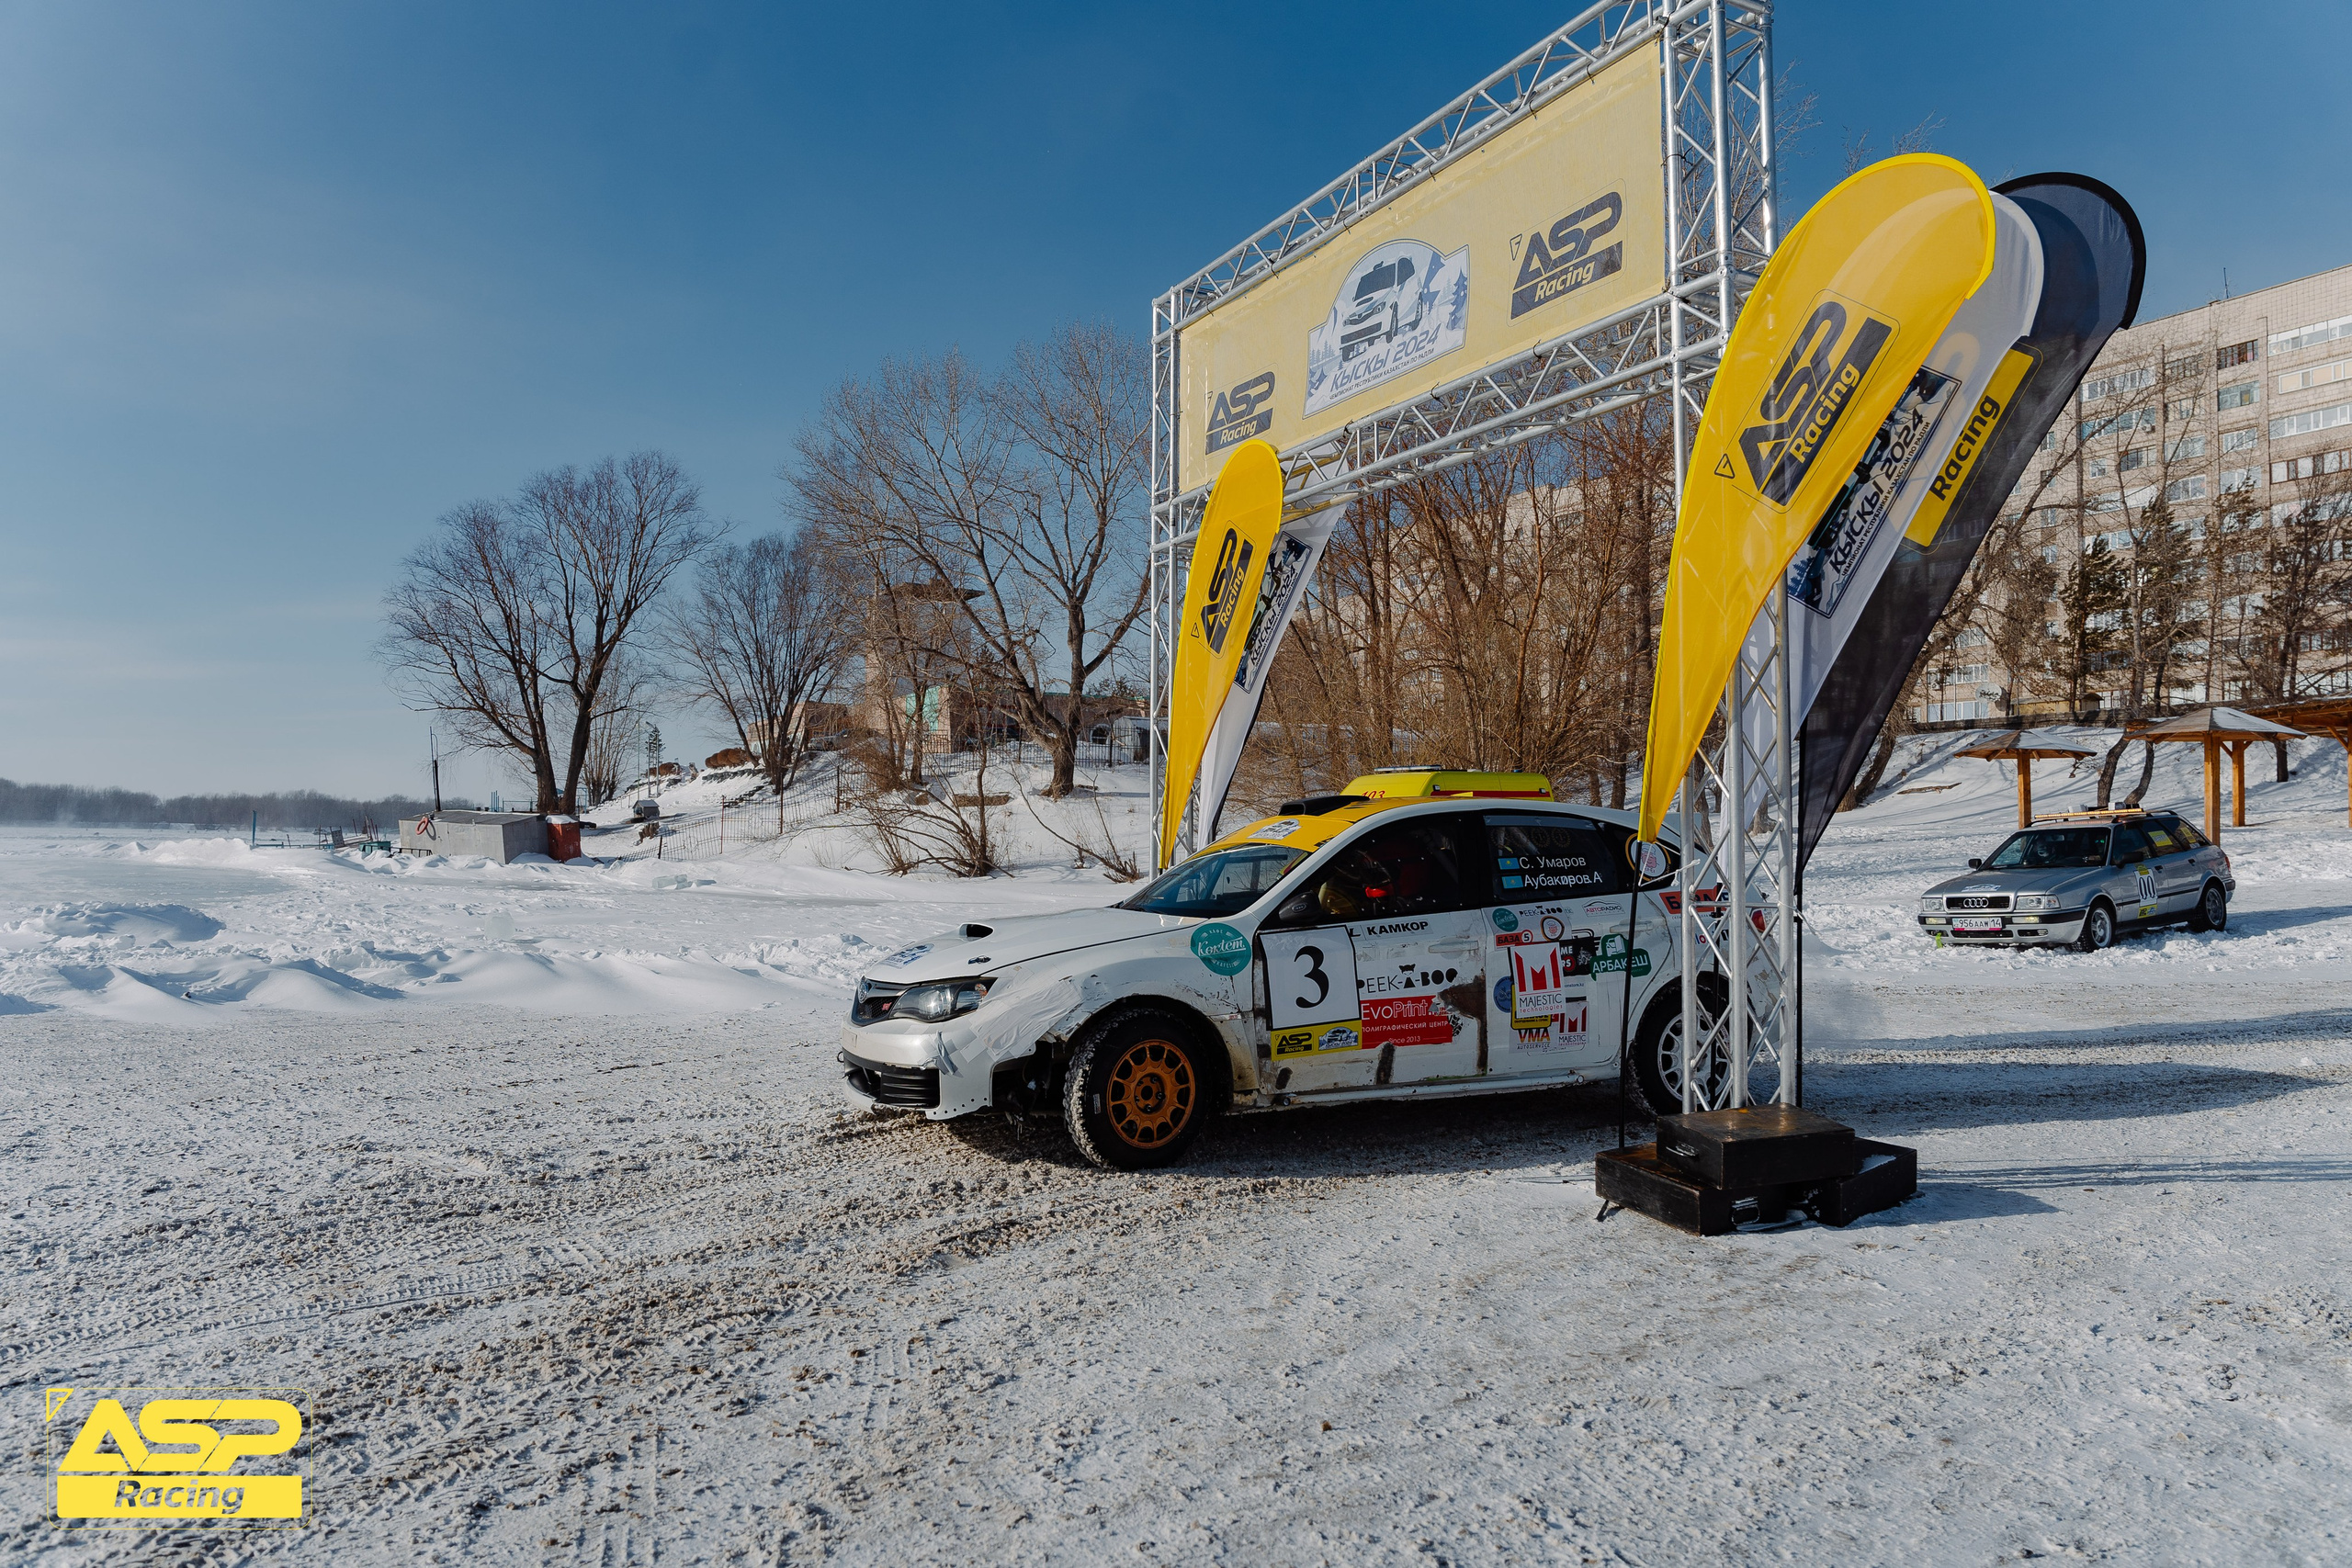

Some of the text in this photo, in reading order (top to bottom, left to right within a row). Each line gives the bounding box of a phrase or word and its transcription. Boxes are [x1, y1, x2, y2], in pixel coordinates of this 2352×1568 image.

[1513, 191, 1623, 290] ASP
[1534, 261, 1596, 302] Racing
[1392, 322, 1442, 364] 2024
[1206, 371, 1275, 433] ASP
[1738, 301, 1847, 491] ASP
[1789, 362, 1860, 464] Racing
[1220, 420, 1257, 445] Racing
[1880, 407, 1925, 481] 2024
[1929, 394, 2001, 502] Racing
[1841, 537, 1866, 577] ЧЕМПИОНАТ
[1864, 493, 1889, 538] РЕСПУБЛИКИ
[1886, 455, 1911, 496] КАЗАХСТАН
[1908, 444, 1917, 457] ПО
[1201, 528, 1238, 646] ASP
[1219, 566, 1244, 628] Racing
[1276, 566, 1296, 608] 2024
[1519, 856, 1587, 870] С. Умаров
[1366, 921, 1429, 935] КАМКОР
[1585, 905, 1623, 914] АВТОРАДИО
[1990, 919, 2001, 928] 14
[1498, 933, 1530, 944] БАЗА 5
[1294, 945, 1329, 1009] 3
[1519, 994, 1563, 1008] MAJESTIC
[1520, 1004, 1563, 1013] technologies
[1277, 1032, 1312, 1047] ASP
[1284, 1044, 1305, 1053] Racing
[1518, 1029, 1551, 1043] VMA
[1558, 1034, 1587, 1043] MAJESTIC
